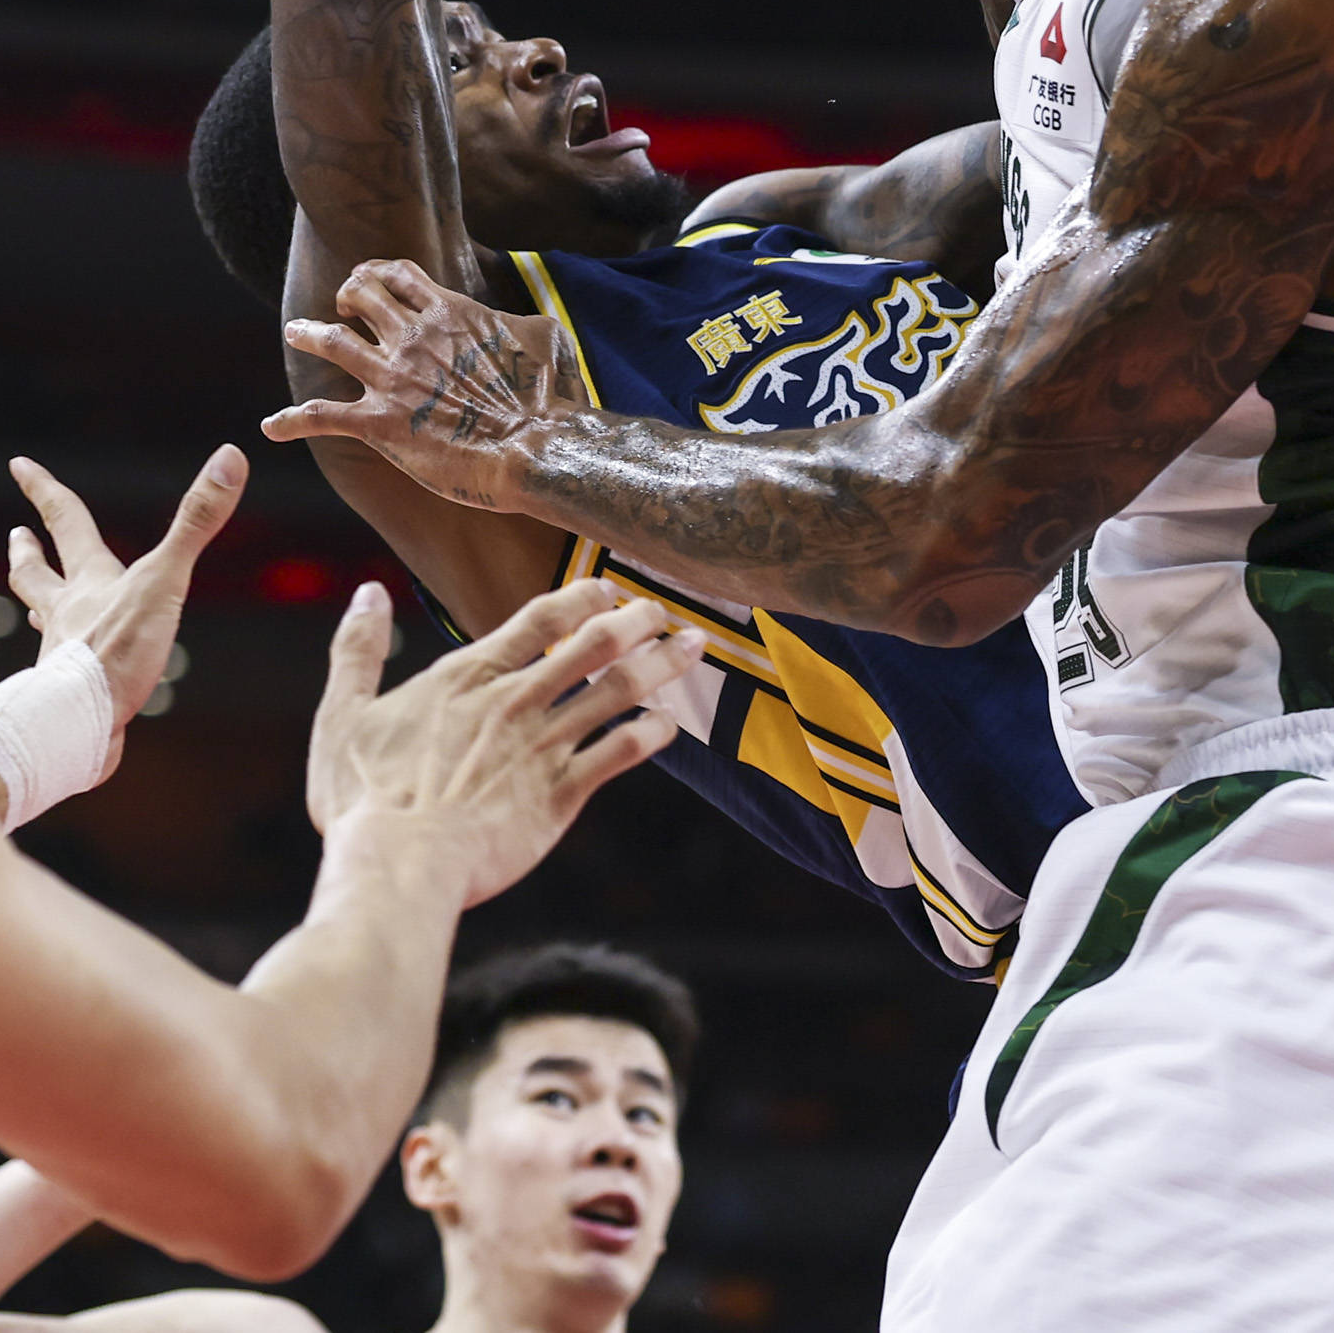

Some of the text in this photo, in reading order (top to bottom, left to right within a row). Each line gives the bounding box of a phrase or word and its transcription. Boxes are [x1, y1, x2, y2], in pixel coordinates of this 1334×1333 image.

[1028, 74, 1076, 107] 广发银行
[1033, 103, 1063, 132] CGB
